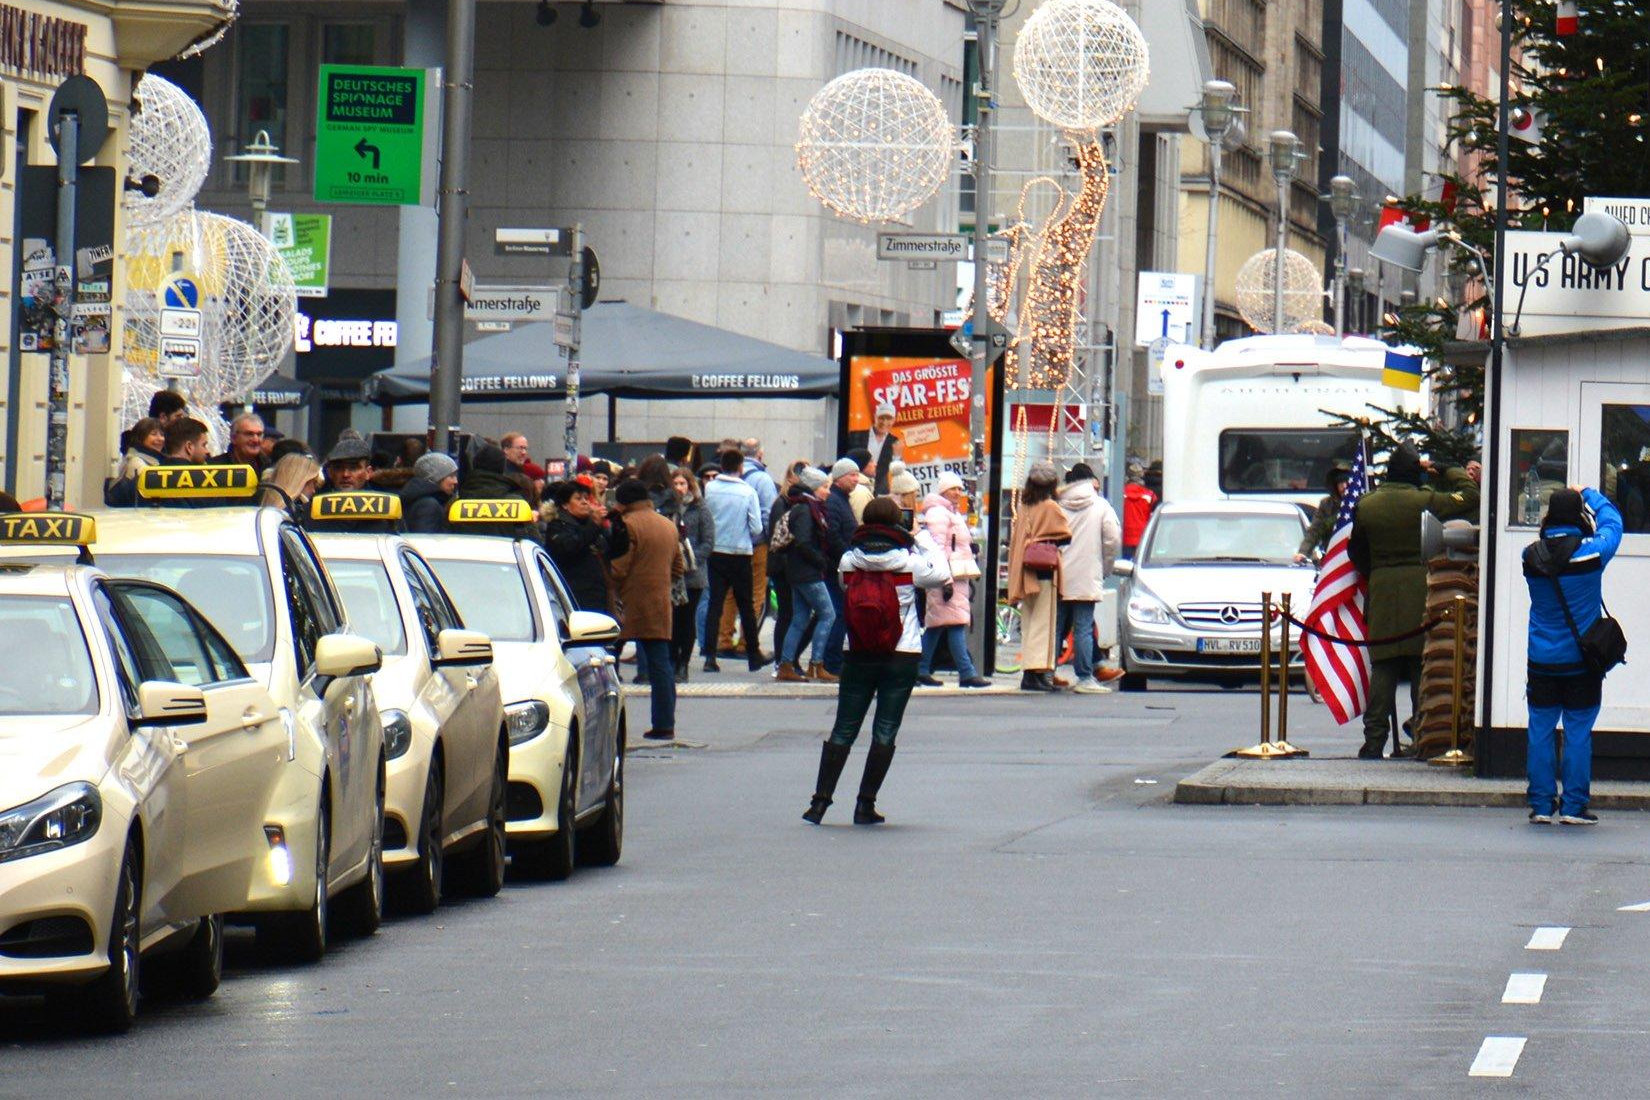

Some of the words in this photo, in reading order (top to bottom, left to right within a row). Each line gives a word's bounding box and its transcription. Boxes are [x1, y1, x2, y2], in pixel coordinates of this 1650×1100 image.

[333, 79, 412, 93] DEUTSCHES
[332, 92, 403, 106] SPIONAGE
[332, 106, 393, 118] MUSEUM
[326, 124, 359, 132] GERMAN
[363, 125, 377, 133] SPY
[379, 126, 414, 134] MUSEUM
[347, 172, 361, 183] 10
[364, 172, 389, 184] min
[886, 237, 962, 255] Zimmerstraße
[313, 319, 372, 347] COFFEE
[503, 374, 557, 389] FELLOWS
[701, 374, 745, 388] COFFEE
[746, 374, 799, 389] FELLOWS
[891, 370, 912, 383] DAS
[914, 364, 959, 380] GRÖSSTE
[267, 391, 301, 404] FELLOWS
[873, 377, 972, 408] SPAR-FES
[896, 408, 924, 423] ALLER
[926, 402, 965, 419] ZEITEN!
[157, 469, 236, 489] TAXI
[325, 494, 386, 514] TAXI
[461, 502, 520, 521] TAXI
[3, 518, 73, 539] TAXI
[1204, 640, 1222, 651] HVL
